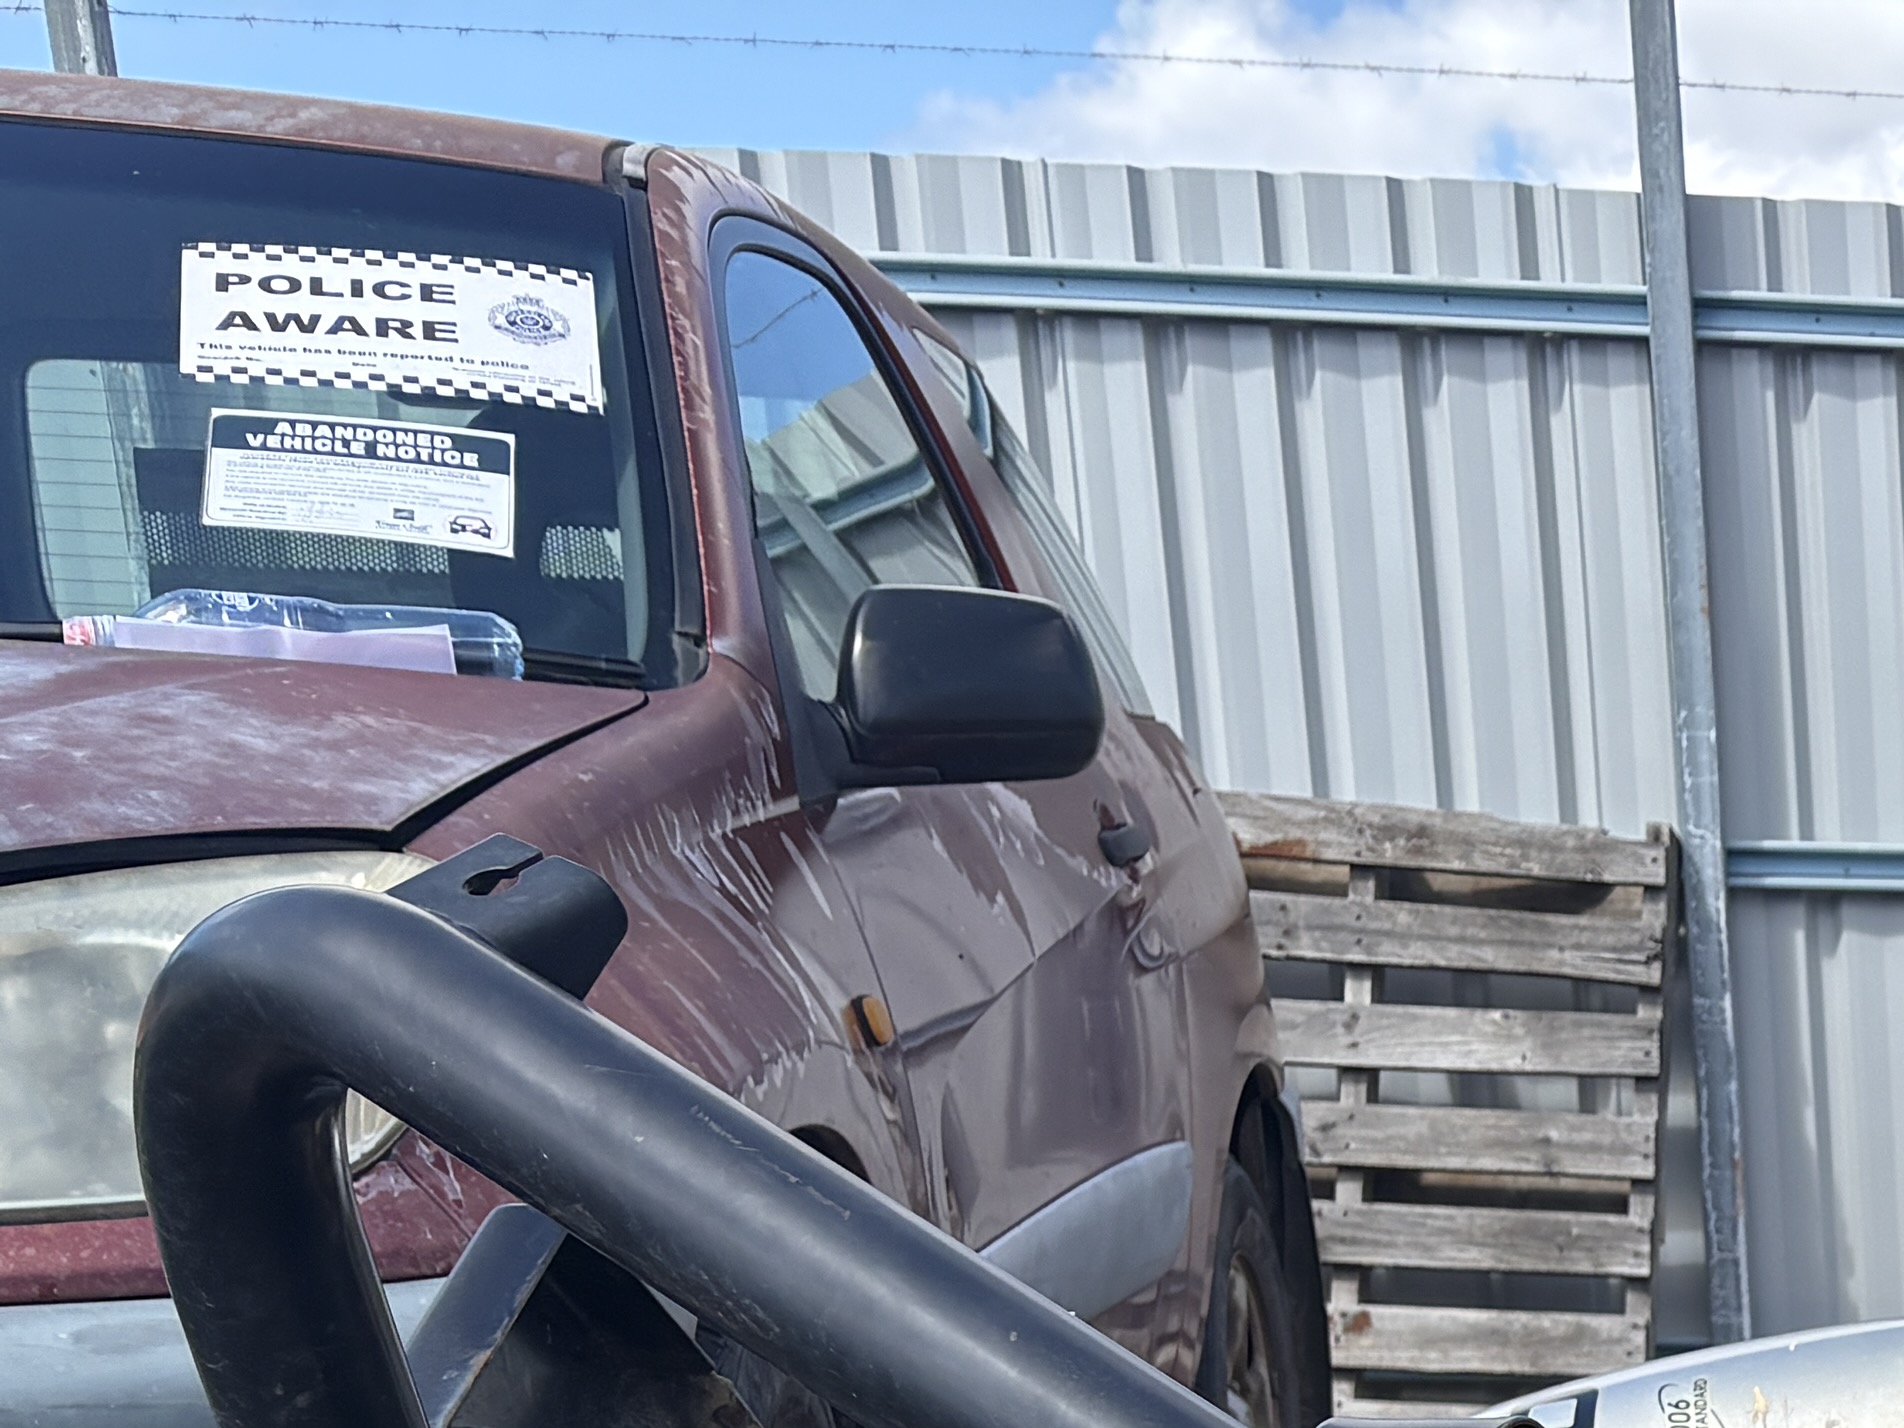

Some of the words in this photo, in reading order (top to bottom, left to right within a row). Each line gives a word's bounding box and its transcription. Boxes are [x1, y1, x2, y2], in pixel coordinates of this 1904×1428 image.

[214, 271, 457, 305] POLICE
[214, 310, 459, 344] AWARE
[196, 341, 233, 351] This
[238, 344, 298, 354] vehicle
[302, 346, 332, 355] has
[336, 348, 378, 358] been
[382, 351, 454, 363] reported
[459, 356, 475, 365] to
[480, 359, 530, 371] police
[244, 432, 367, 456] VEHICLE
[376, 443, 480, 468] NOTICE
[273, 420, 453, 450] ABANDONED
